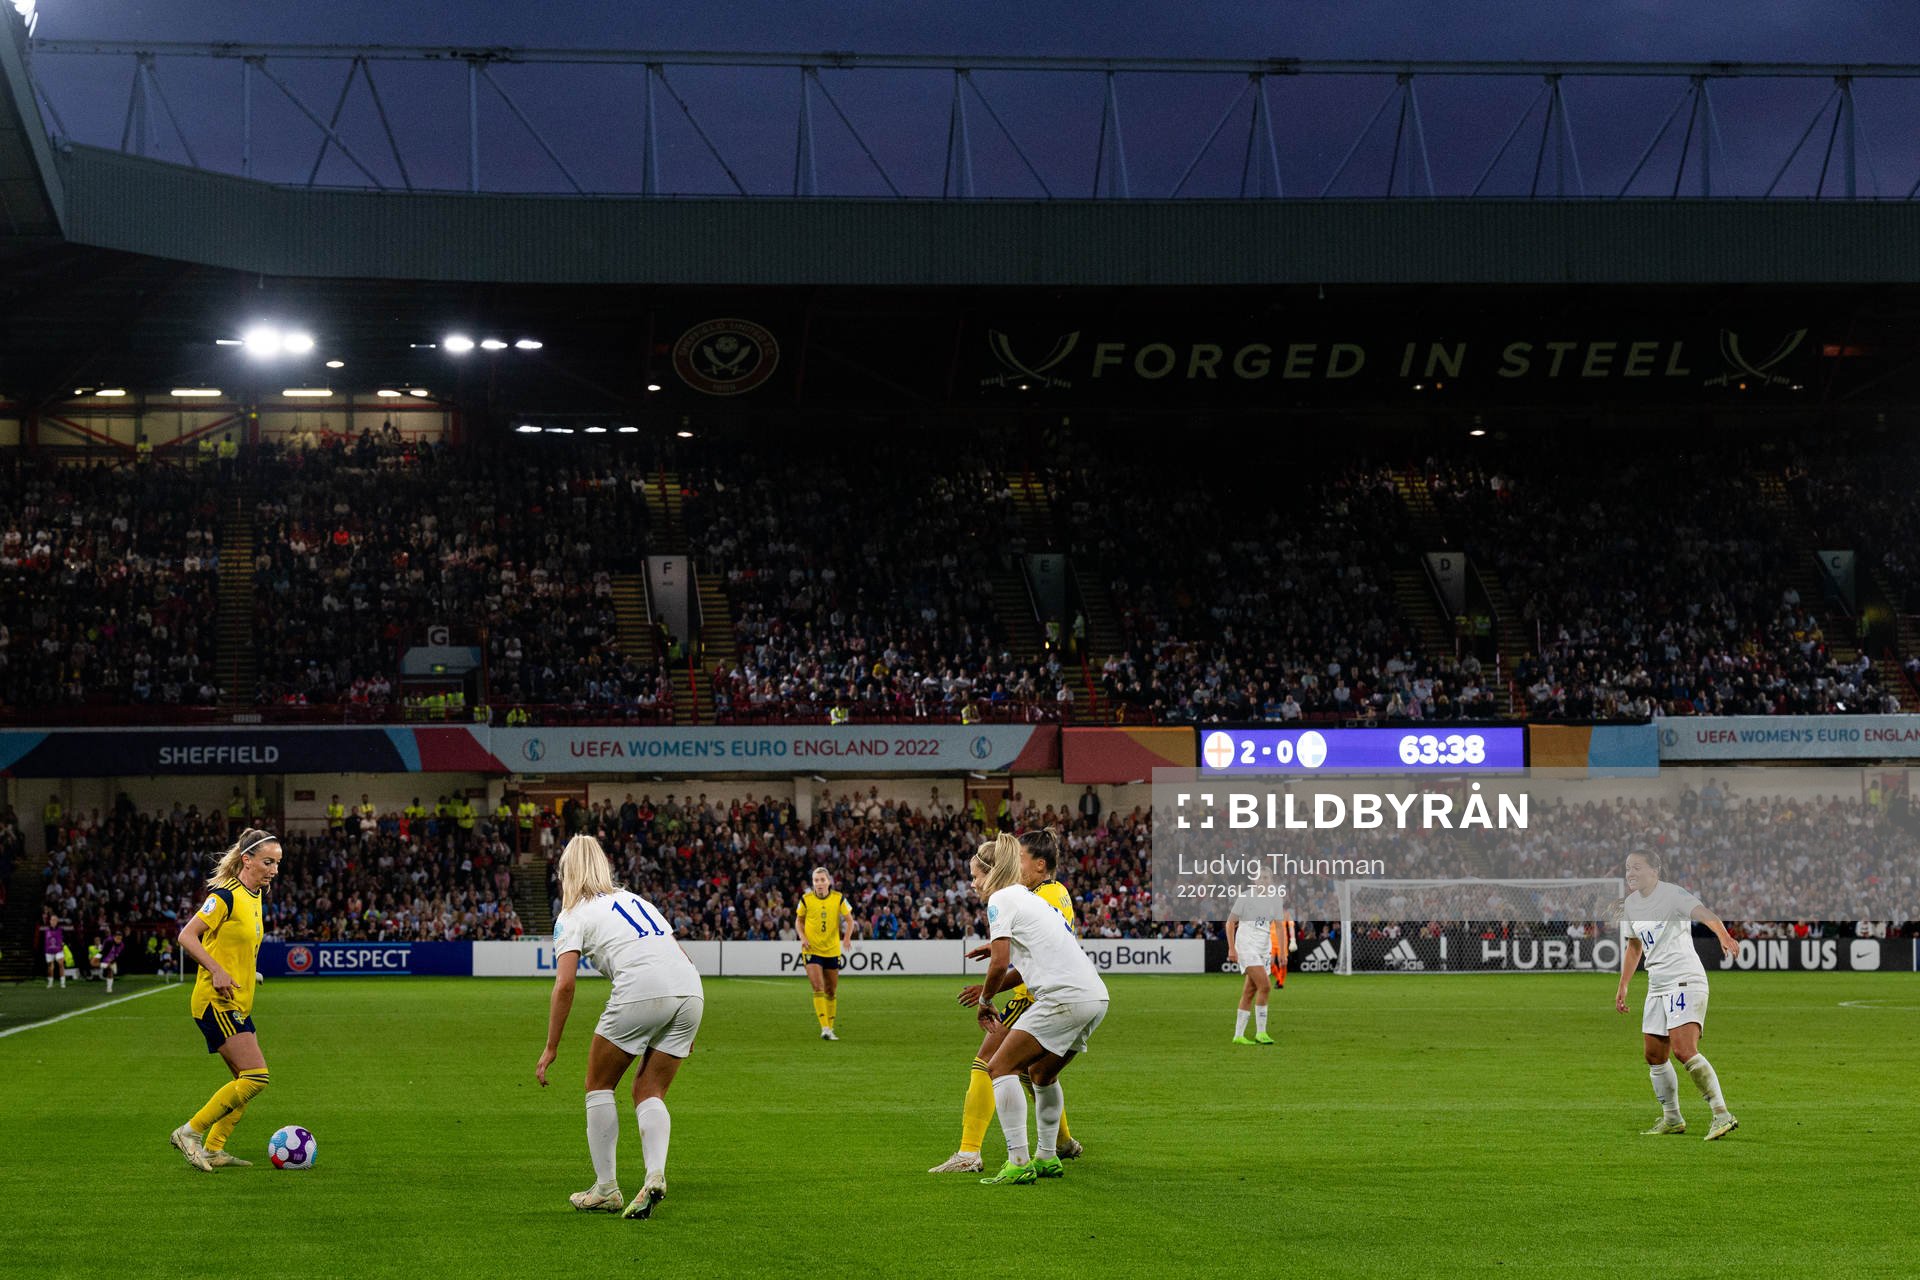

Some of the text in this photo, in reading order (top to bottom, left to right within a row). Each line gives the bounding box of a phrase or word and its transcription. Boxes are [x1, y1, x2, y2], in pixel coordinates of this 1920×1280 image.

[1091, 340, 1691, 380] FORGED IN STEEL
[663, 561, 673, 574] F
[1041, 560, 1050, 572] E
[1441, 559, 1450, 571] D
[1831, 556, 1841, 569] C
[431, 628, 447, 645] G
[1696, 729, 1738, 744] UEFA
[1740, 729, 1814, 744] WOMEN'S
[1817, 728, 1860, 742] EURO
[159, 745, 280, 765] SHEFFIELD
[571, 739, 940, 758] UEFA WOMEN'S EURO ENGLAND 2022
[1398, 734, 1486, 765] 63:38
[611, 898, 665, 938] 11
[820, 921, 827, 932] 3
[1641, 930, 1655, 950] 14
[319, 950, 412, 968] RESPECT
[1117, 946, 1172, 965] Bank
[1720, 939, 1838, 970] JOIN US
[1668, 992, 1686, 1013] 14
